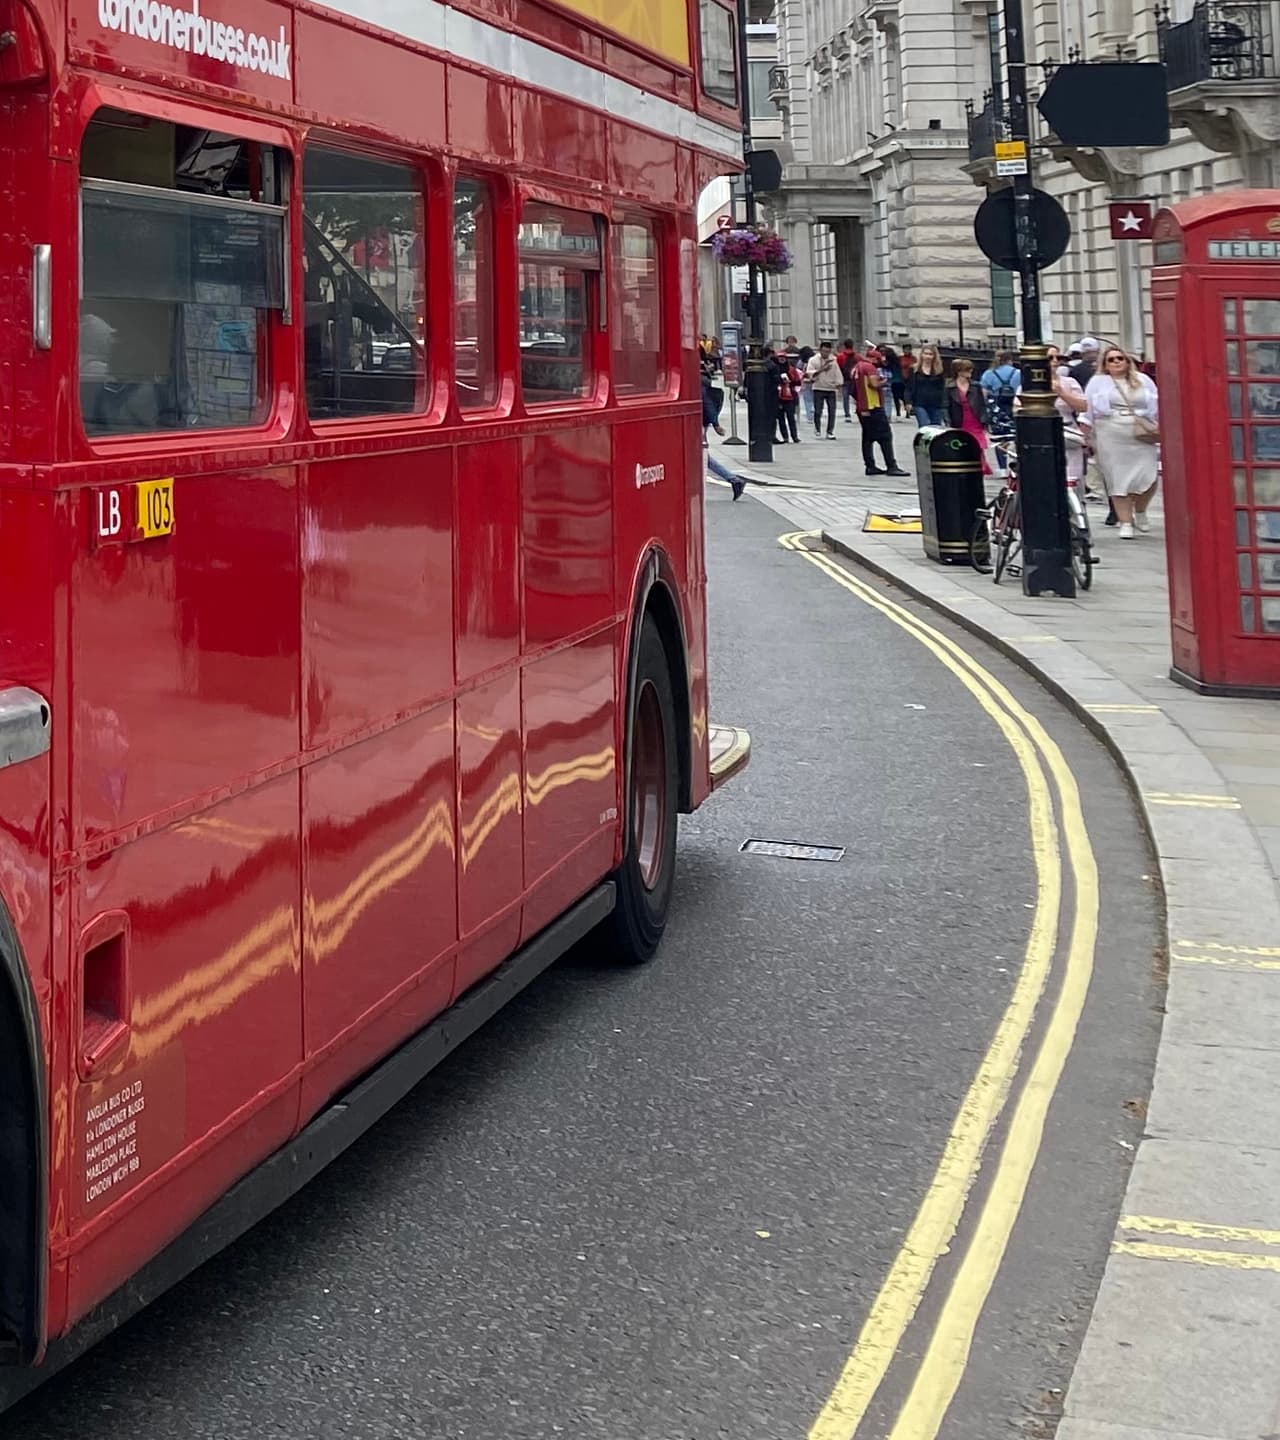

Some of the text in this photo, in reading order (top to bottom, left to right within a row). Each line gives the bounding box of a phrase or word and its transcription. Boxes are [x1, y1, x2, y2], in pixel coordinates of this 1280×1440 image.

[98, 486, 171, 537] LB 103
[86, 1174, 112, 1203] LONDON
